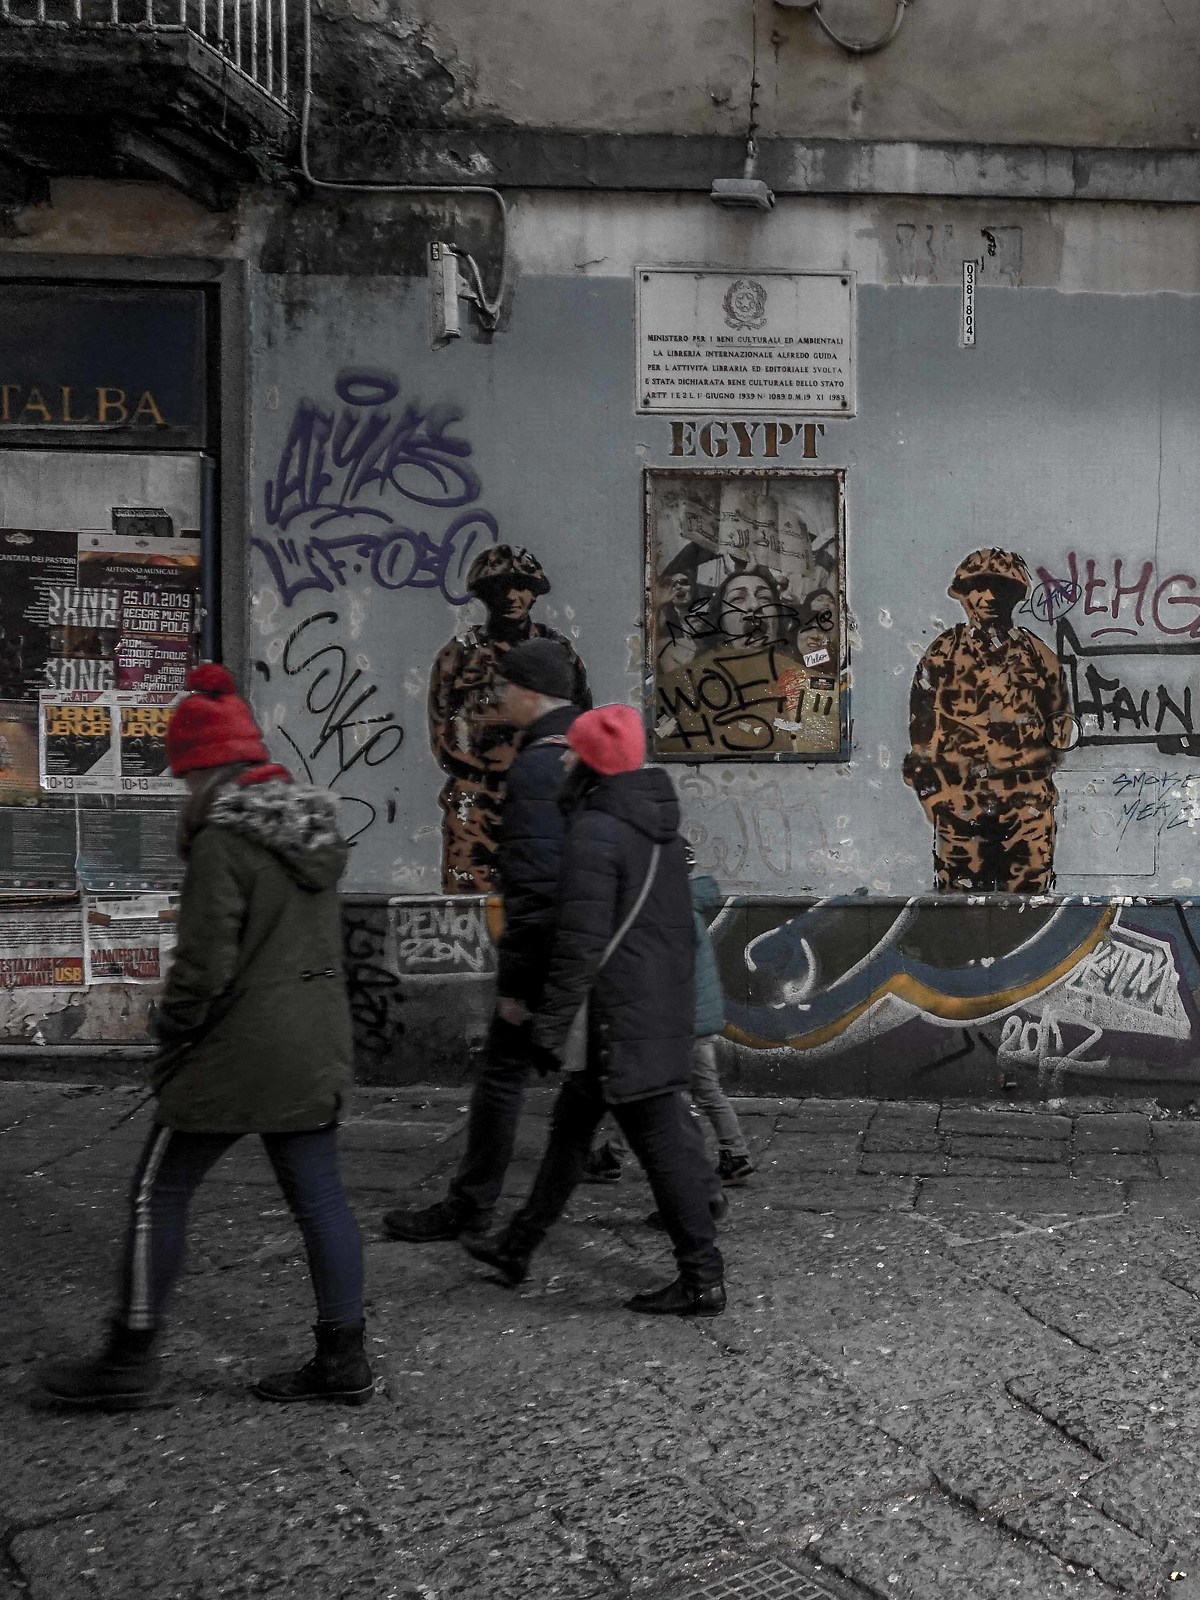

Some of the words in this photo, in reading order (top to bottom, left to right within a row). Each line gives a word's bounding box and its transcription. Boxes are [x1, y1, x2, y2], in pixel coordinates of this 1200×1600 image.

[738, 336, 780, 344] CULTURALI
[706, 350, 772, 358] INTERNAZIONALE
[669, 421, 825, 459] EGYPT
[105, 566, 143, 574] AUTUNNO
[123, 590, 190, 607] 25.01.2019
[123, 608, 160, 619] REGGAE
[161, 610, 189, 621] MUSIC
[131, 620, 157, 631] LIDO
[160, 621, 189, 632] POLA
[120, 649, 154, 658] CINQUE
[155, 651, 187, 660] CINQUE
[55, 967, 82, 983] USB
